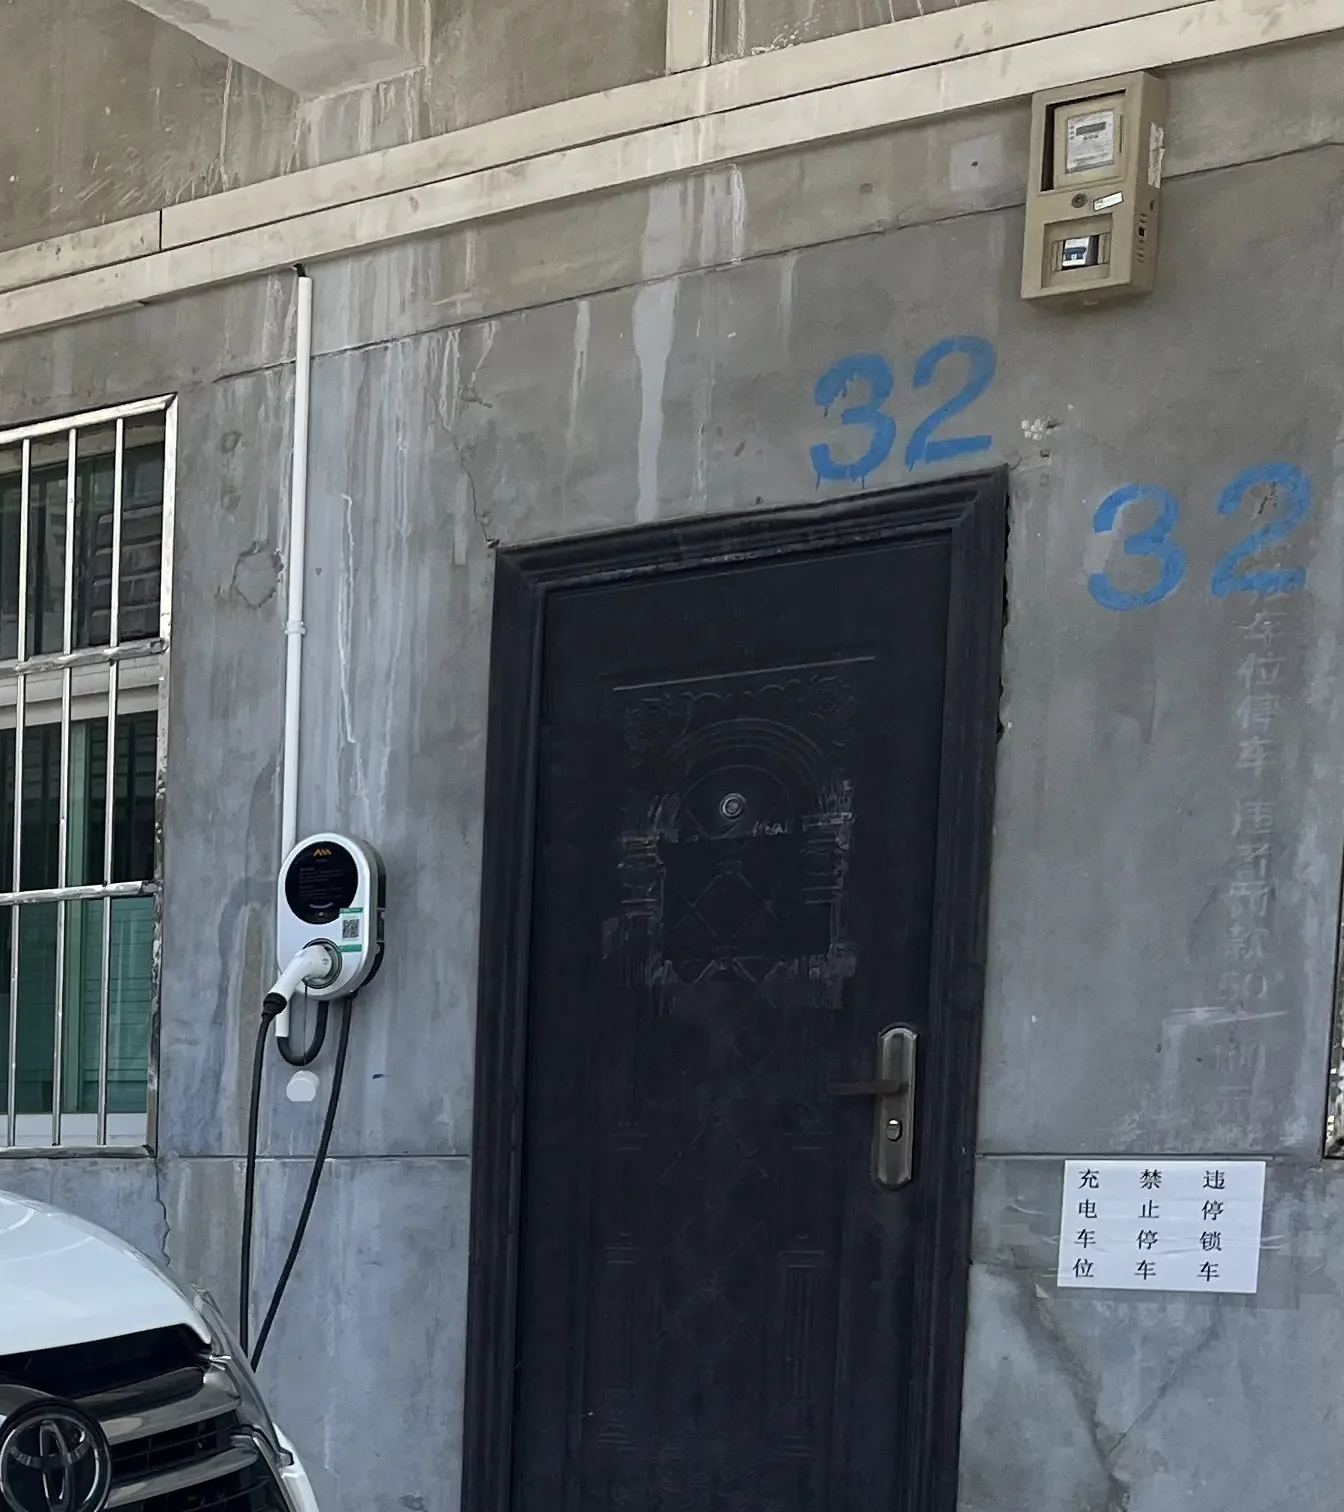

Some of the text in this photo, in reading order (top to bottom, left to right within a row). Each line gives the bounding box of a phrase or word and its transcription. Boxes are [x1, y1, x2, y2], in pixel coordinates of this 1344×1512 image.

[809, 335, 998, 481] 32
[1087, 461, 1313, 612] 32
[1072, 1168, 1100, 1279] 充电车位
[1134, 1169, 1163, 1281] 禁止停车
[1197, 1169, 1226, 1282] 违停锁车
